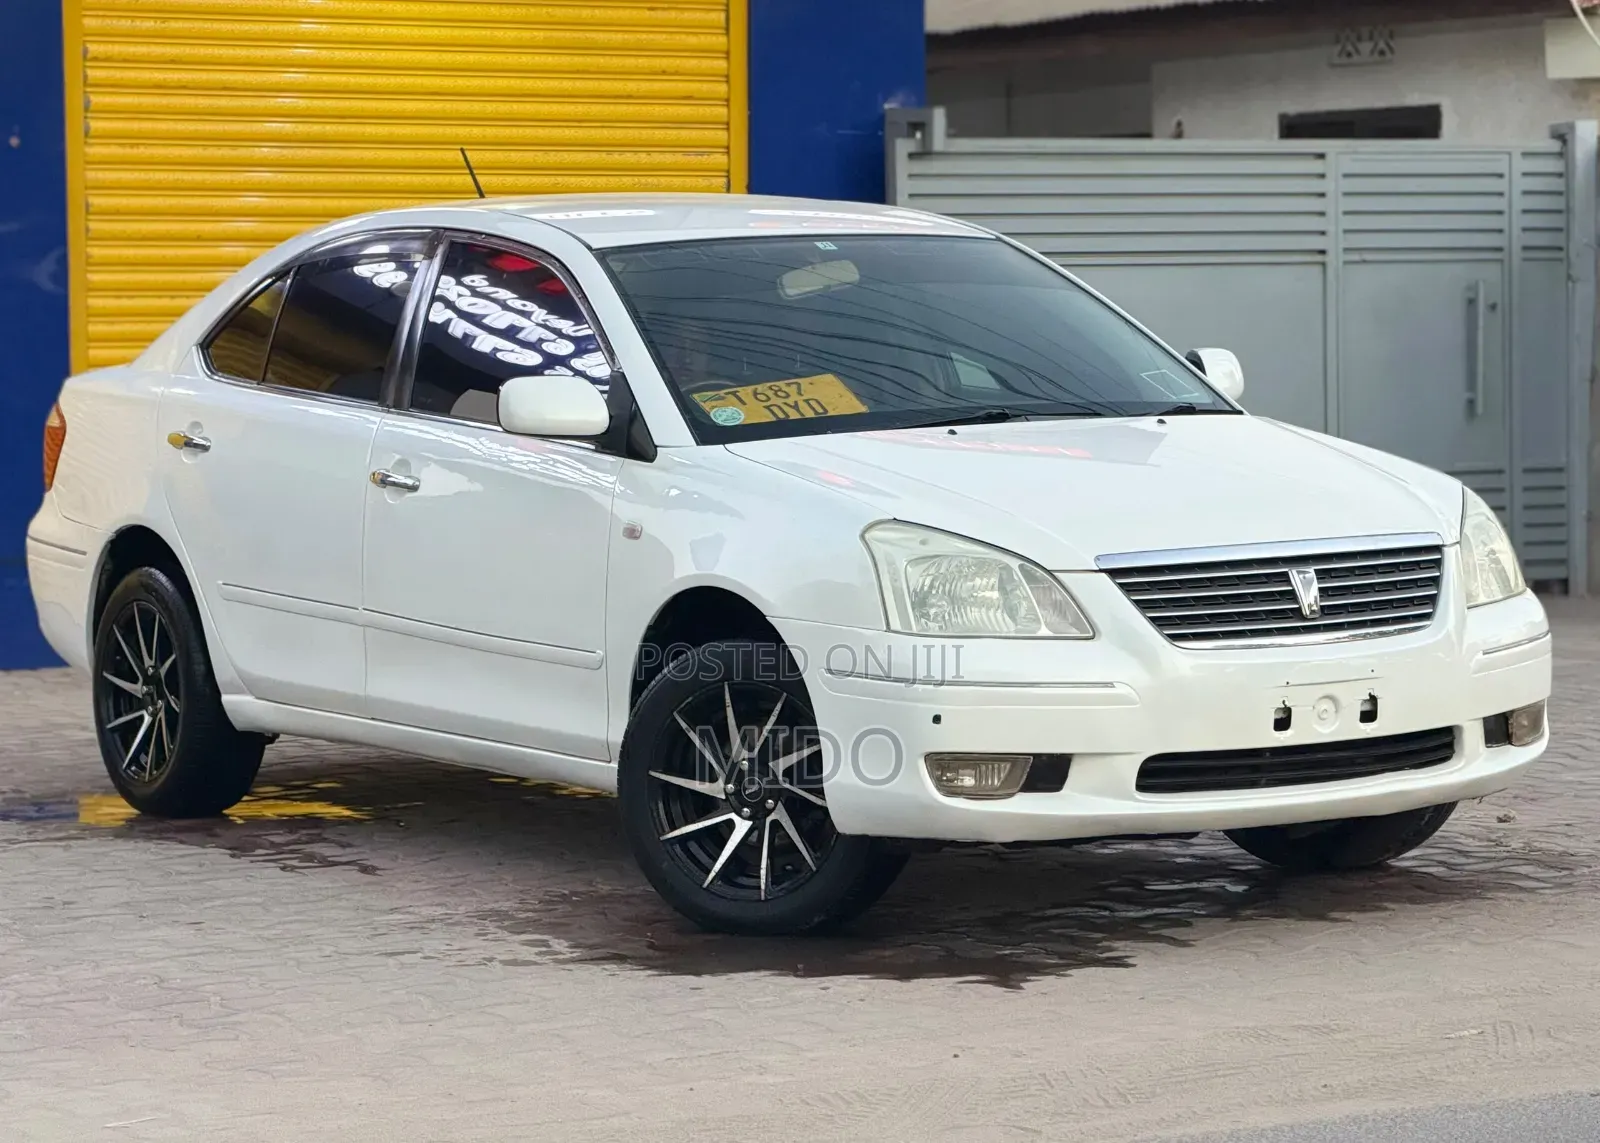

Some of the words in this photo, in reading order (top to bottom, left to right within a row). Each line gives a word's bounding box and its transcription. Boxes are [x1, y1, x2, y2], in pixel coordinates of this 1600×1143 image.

[724, 390, 747, 406] T
[752, 381, 805, 403] 687
[762, 398, 828, 421] DYD
